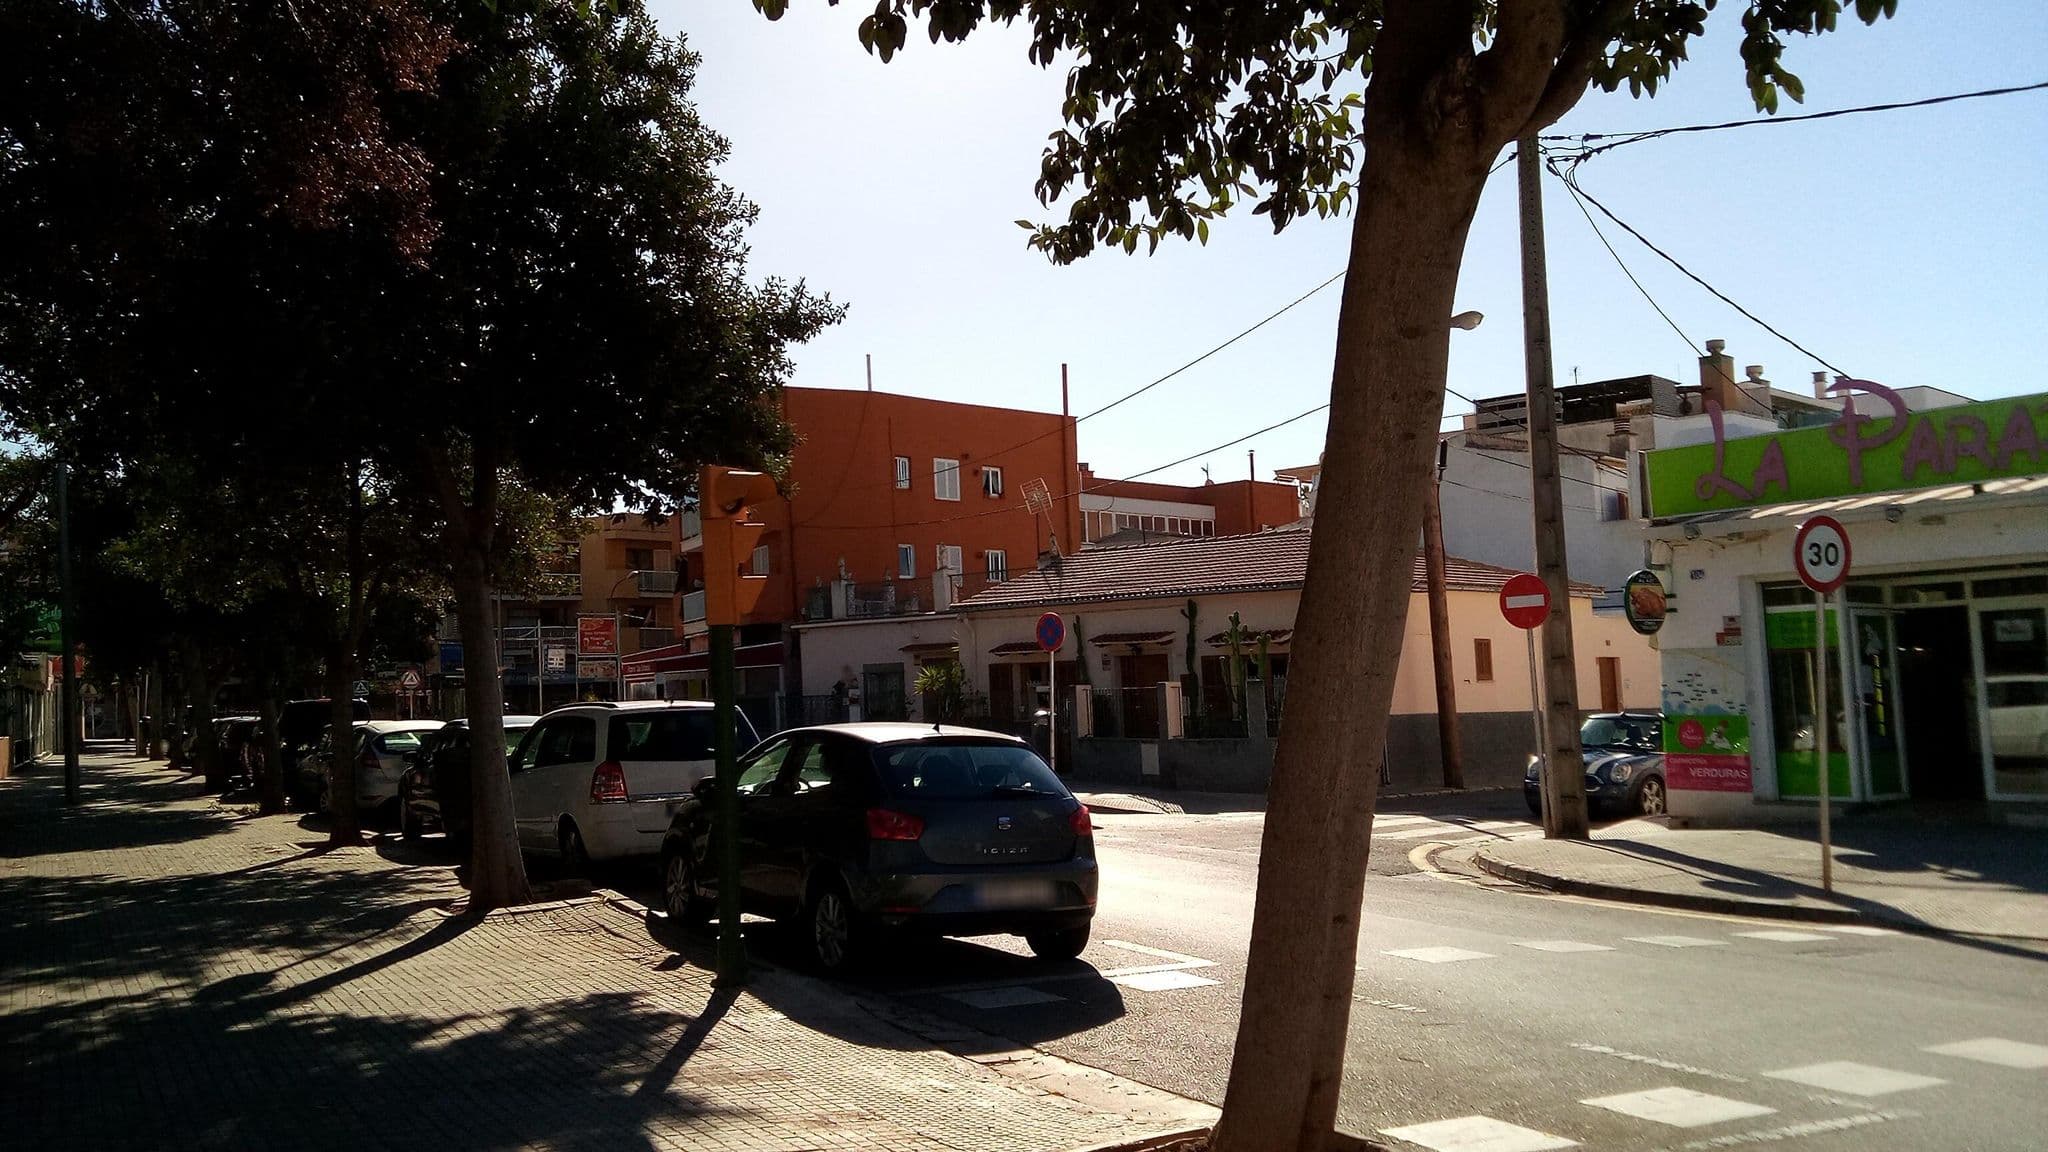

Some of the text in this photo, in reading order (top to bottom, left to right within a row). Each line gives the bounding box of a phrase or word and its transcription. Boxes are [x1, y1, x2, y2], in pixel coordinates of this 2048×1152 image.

[1696, 378, 2048, 499] LA PARA
[1809, 542, 1839, 567] 30
[1688, 767, 1749, 778] VERDURAS
